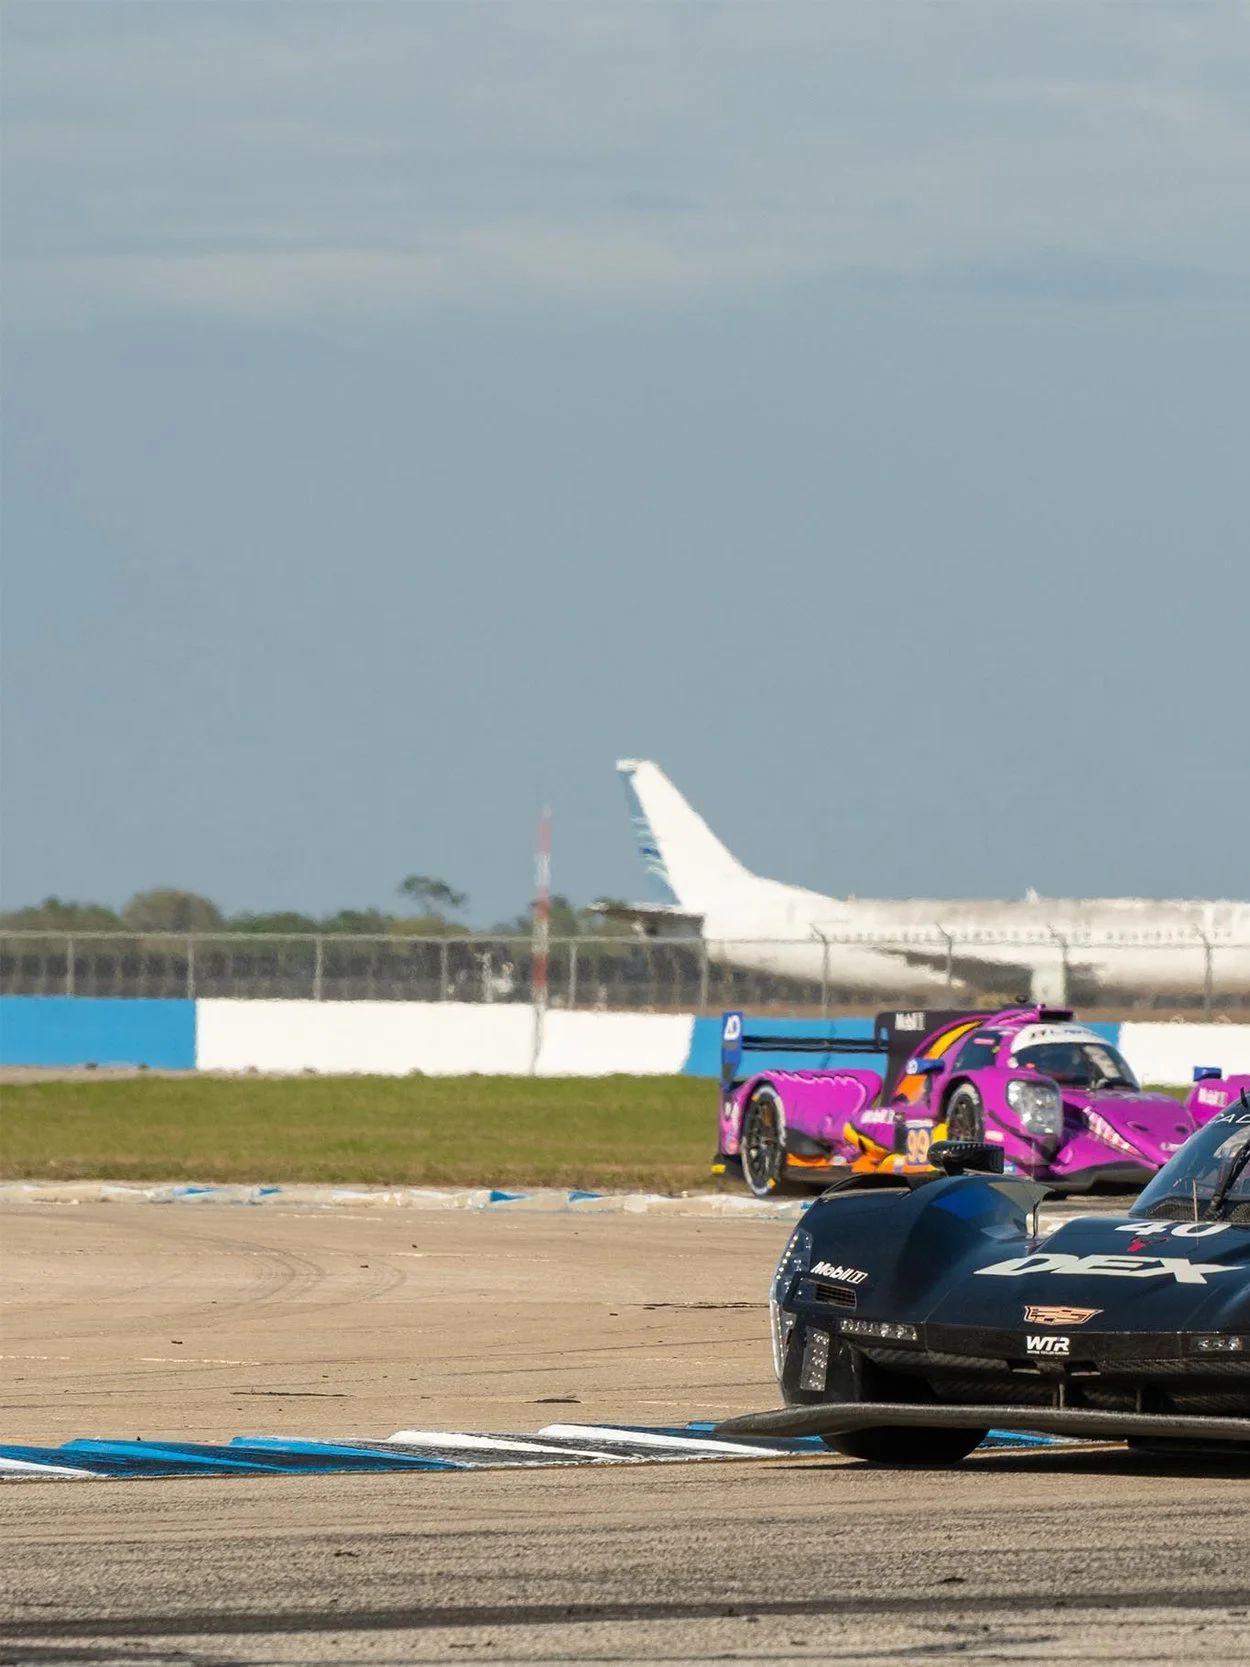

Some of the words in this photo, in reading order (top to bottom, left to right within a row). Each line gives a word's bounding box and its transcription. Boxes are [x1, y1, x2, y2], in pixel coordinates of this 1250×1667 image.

[907, 1128, 930, 1164] 99
[1115, 1221, 1232, 1238] 40
[810, 1261, 855, 1281] Mobil
[973, 1253, 1246, 1284] DEX
[1026, 1335, 1070, 1351] WTR
